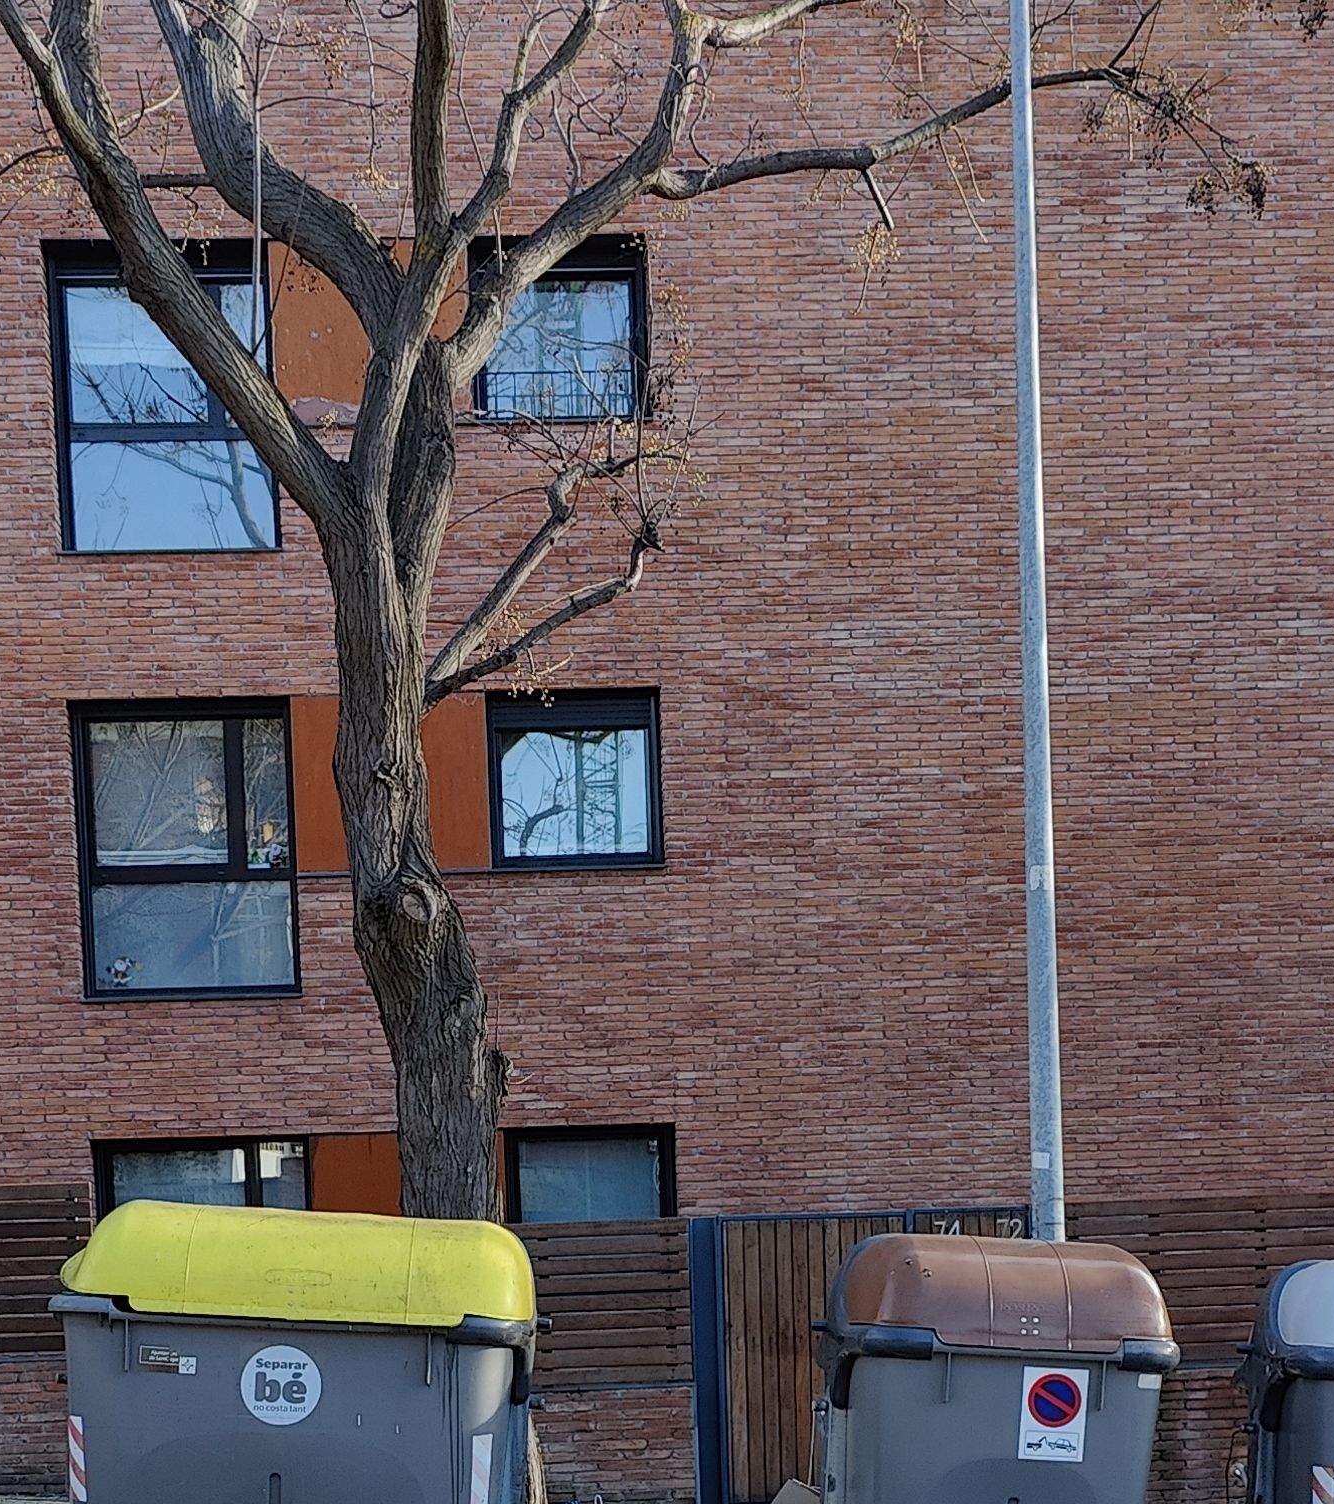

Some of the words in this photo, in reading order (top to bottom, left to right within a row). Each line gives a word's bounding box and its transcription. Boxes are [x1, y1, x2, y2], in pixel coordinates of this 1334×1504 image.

[933, 1219, 960, 1236] 74
[996, 1218, 1023, 1240] 72
[255, 1358, 309, 1371] Separar
[254, 1371, 308, 1404] bé
[253, 1404, 265, 1412] no
[265, 1404, 288, 1413] costa
[289, 1405, 306, 1414] tant
